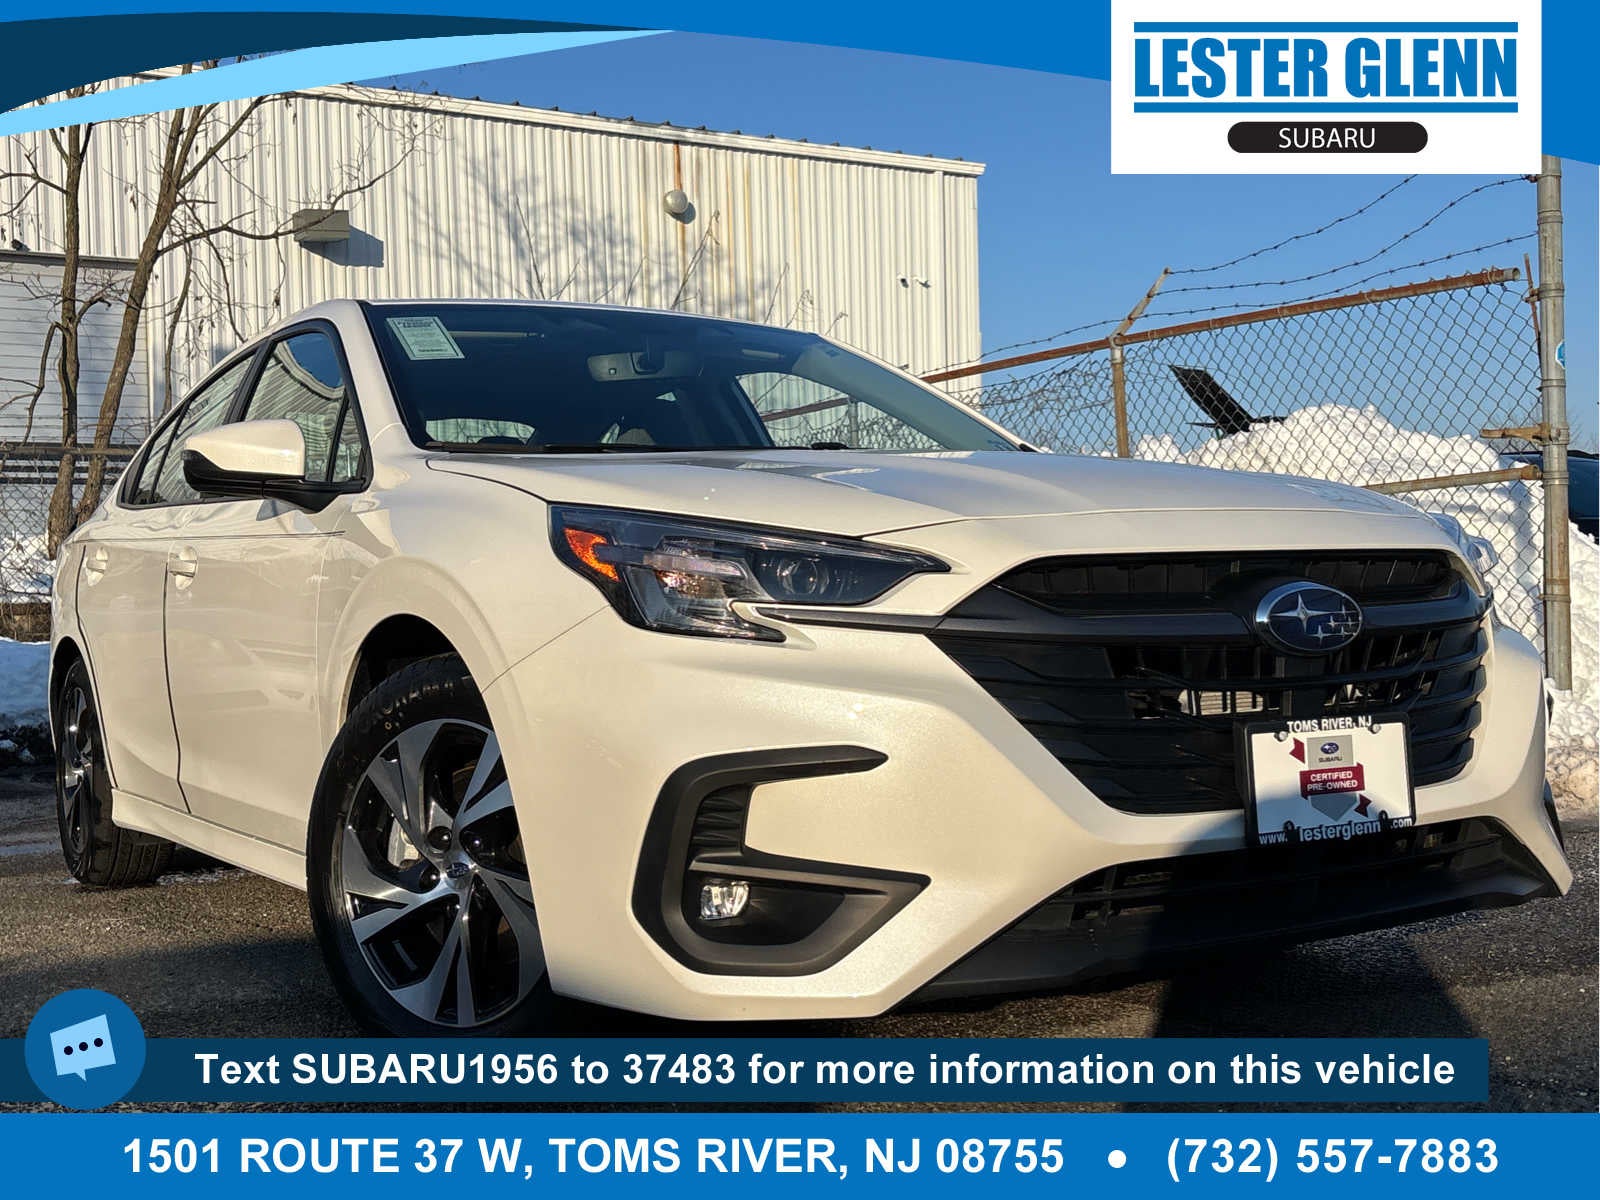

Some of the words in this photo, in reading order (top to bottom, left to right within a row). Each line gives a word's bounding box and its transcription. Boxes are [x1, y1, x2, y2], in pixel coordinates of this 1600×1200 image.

[1287, 719, 1319, 733] TOMS
[1321, 716, 1356, 731] RIVER,
[1358, 715, 1372, 728] NJ
[1310, 771, 1353, 782] CERTIFIED
[1307, 780, 1358, 792] PRE-OWNED
